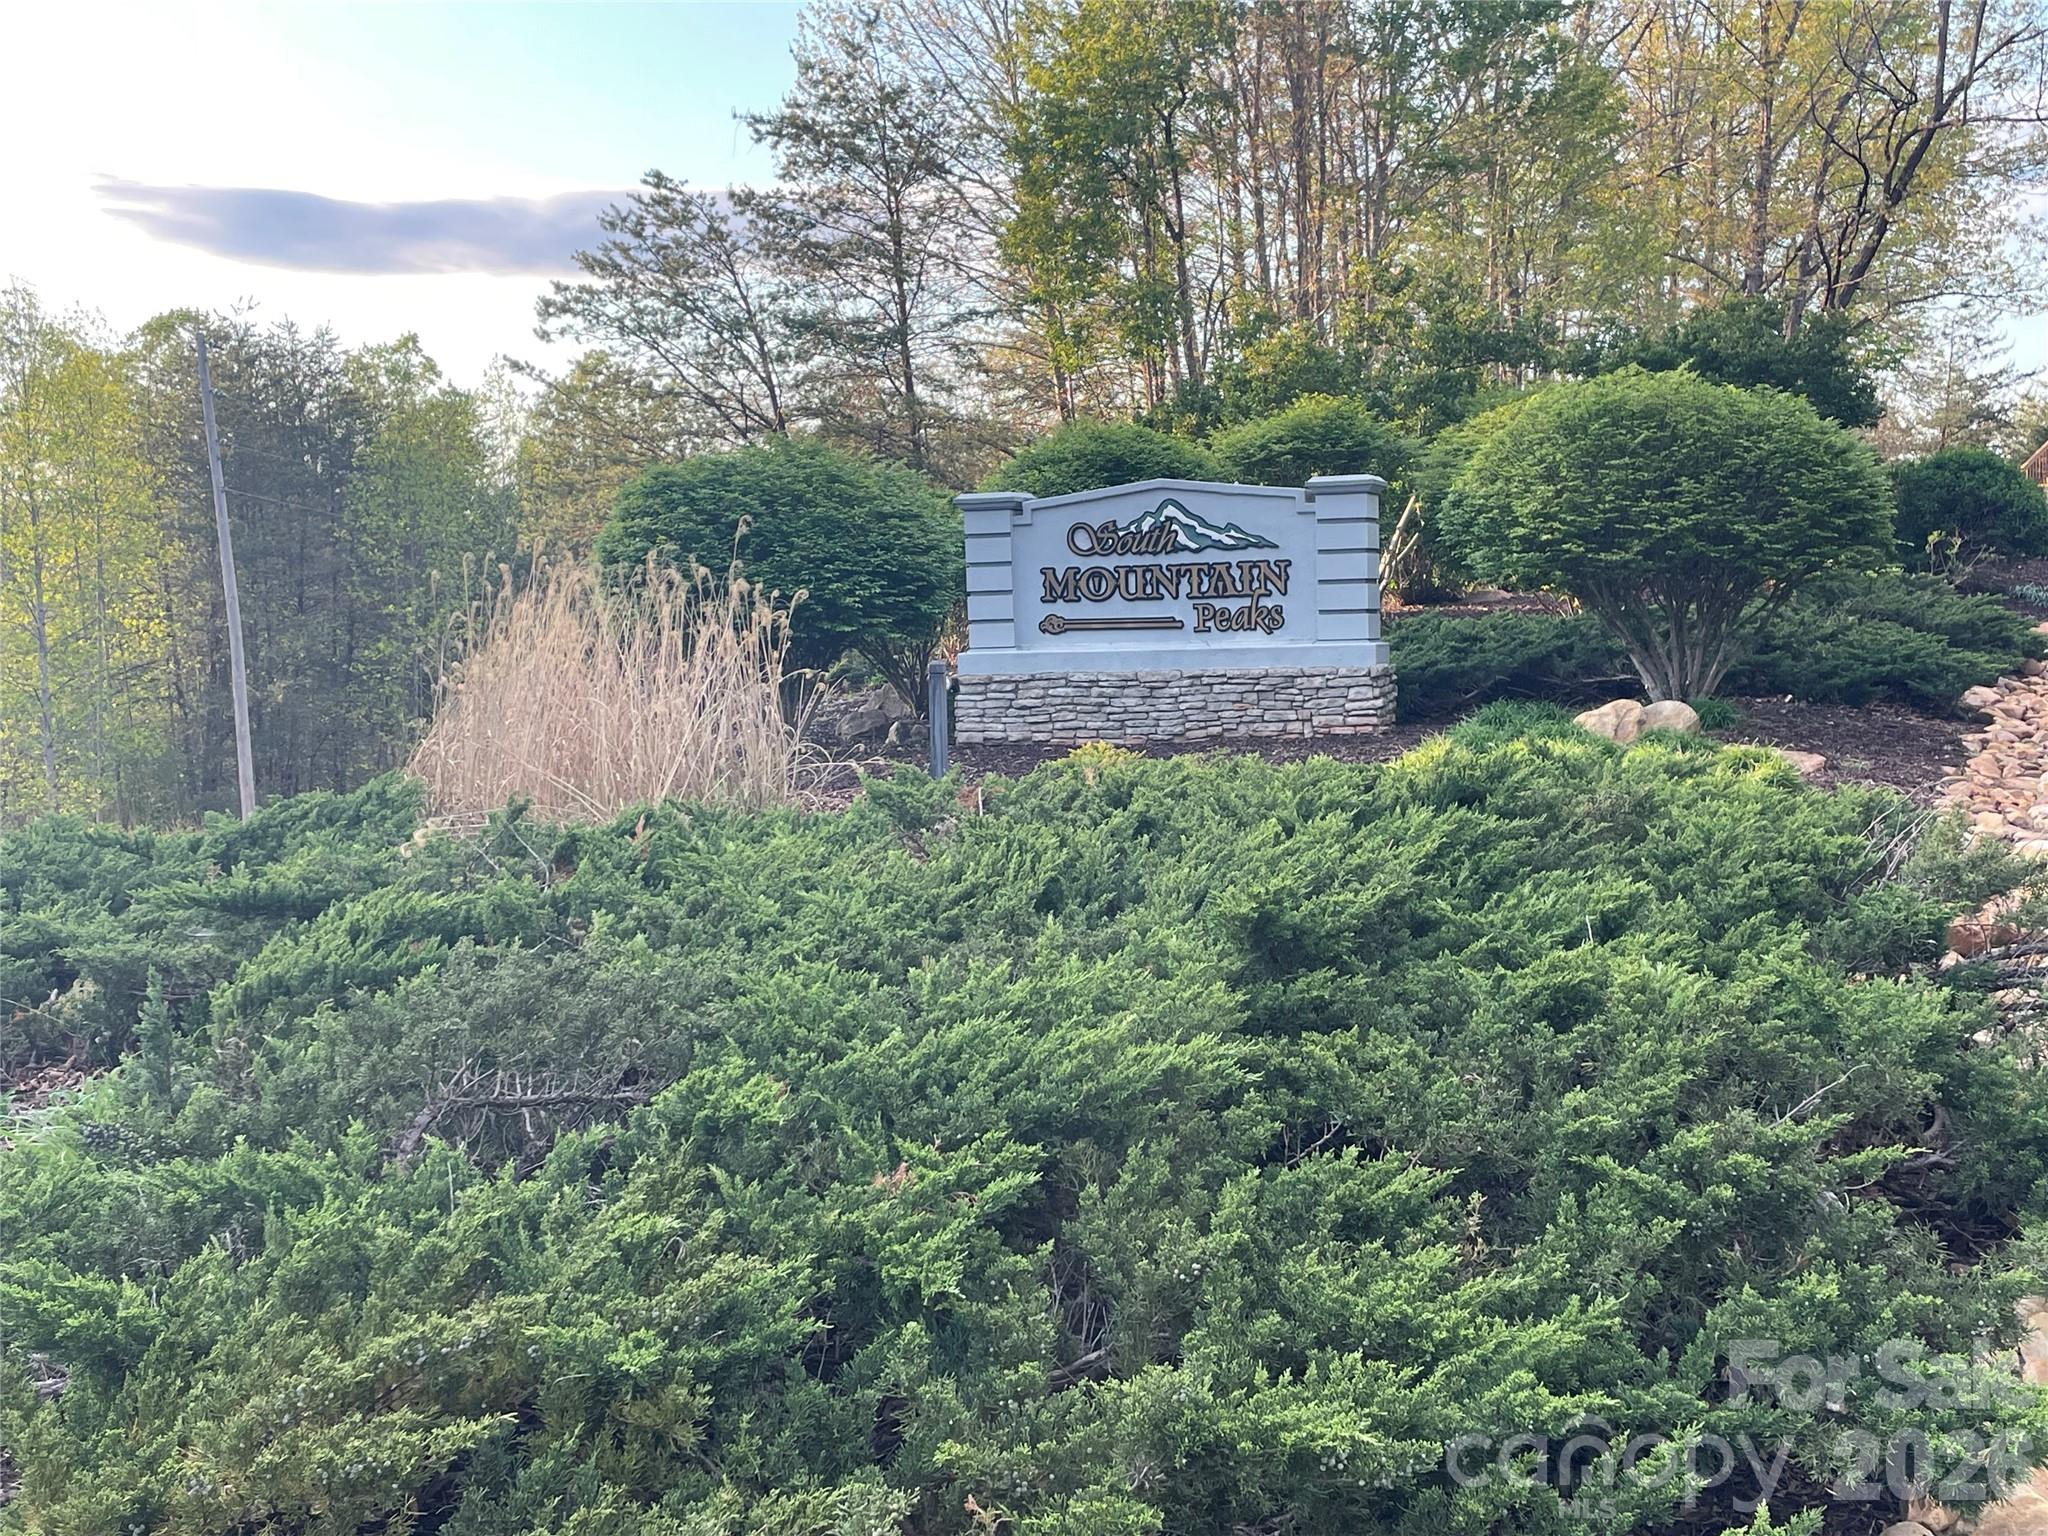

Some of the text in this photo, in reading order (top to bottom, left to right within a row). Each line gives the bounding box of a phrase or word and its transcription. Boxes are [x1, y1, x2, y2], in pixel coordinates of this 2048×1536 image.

[1067, 516, 1179, 556] South
[1040, 560, 1292, 603] MOUNTAIN
[1193, 588, 1285, 635] Peaks
